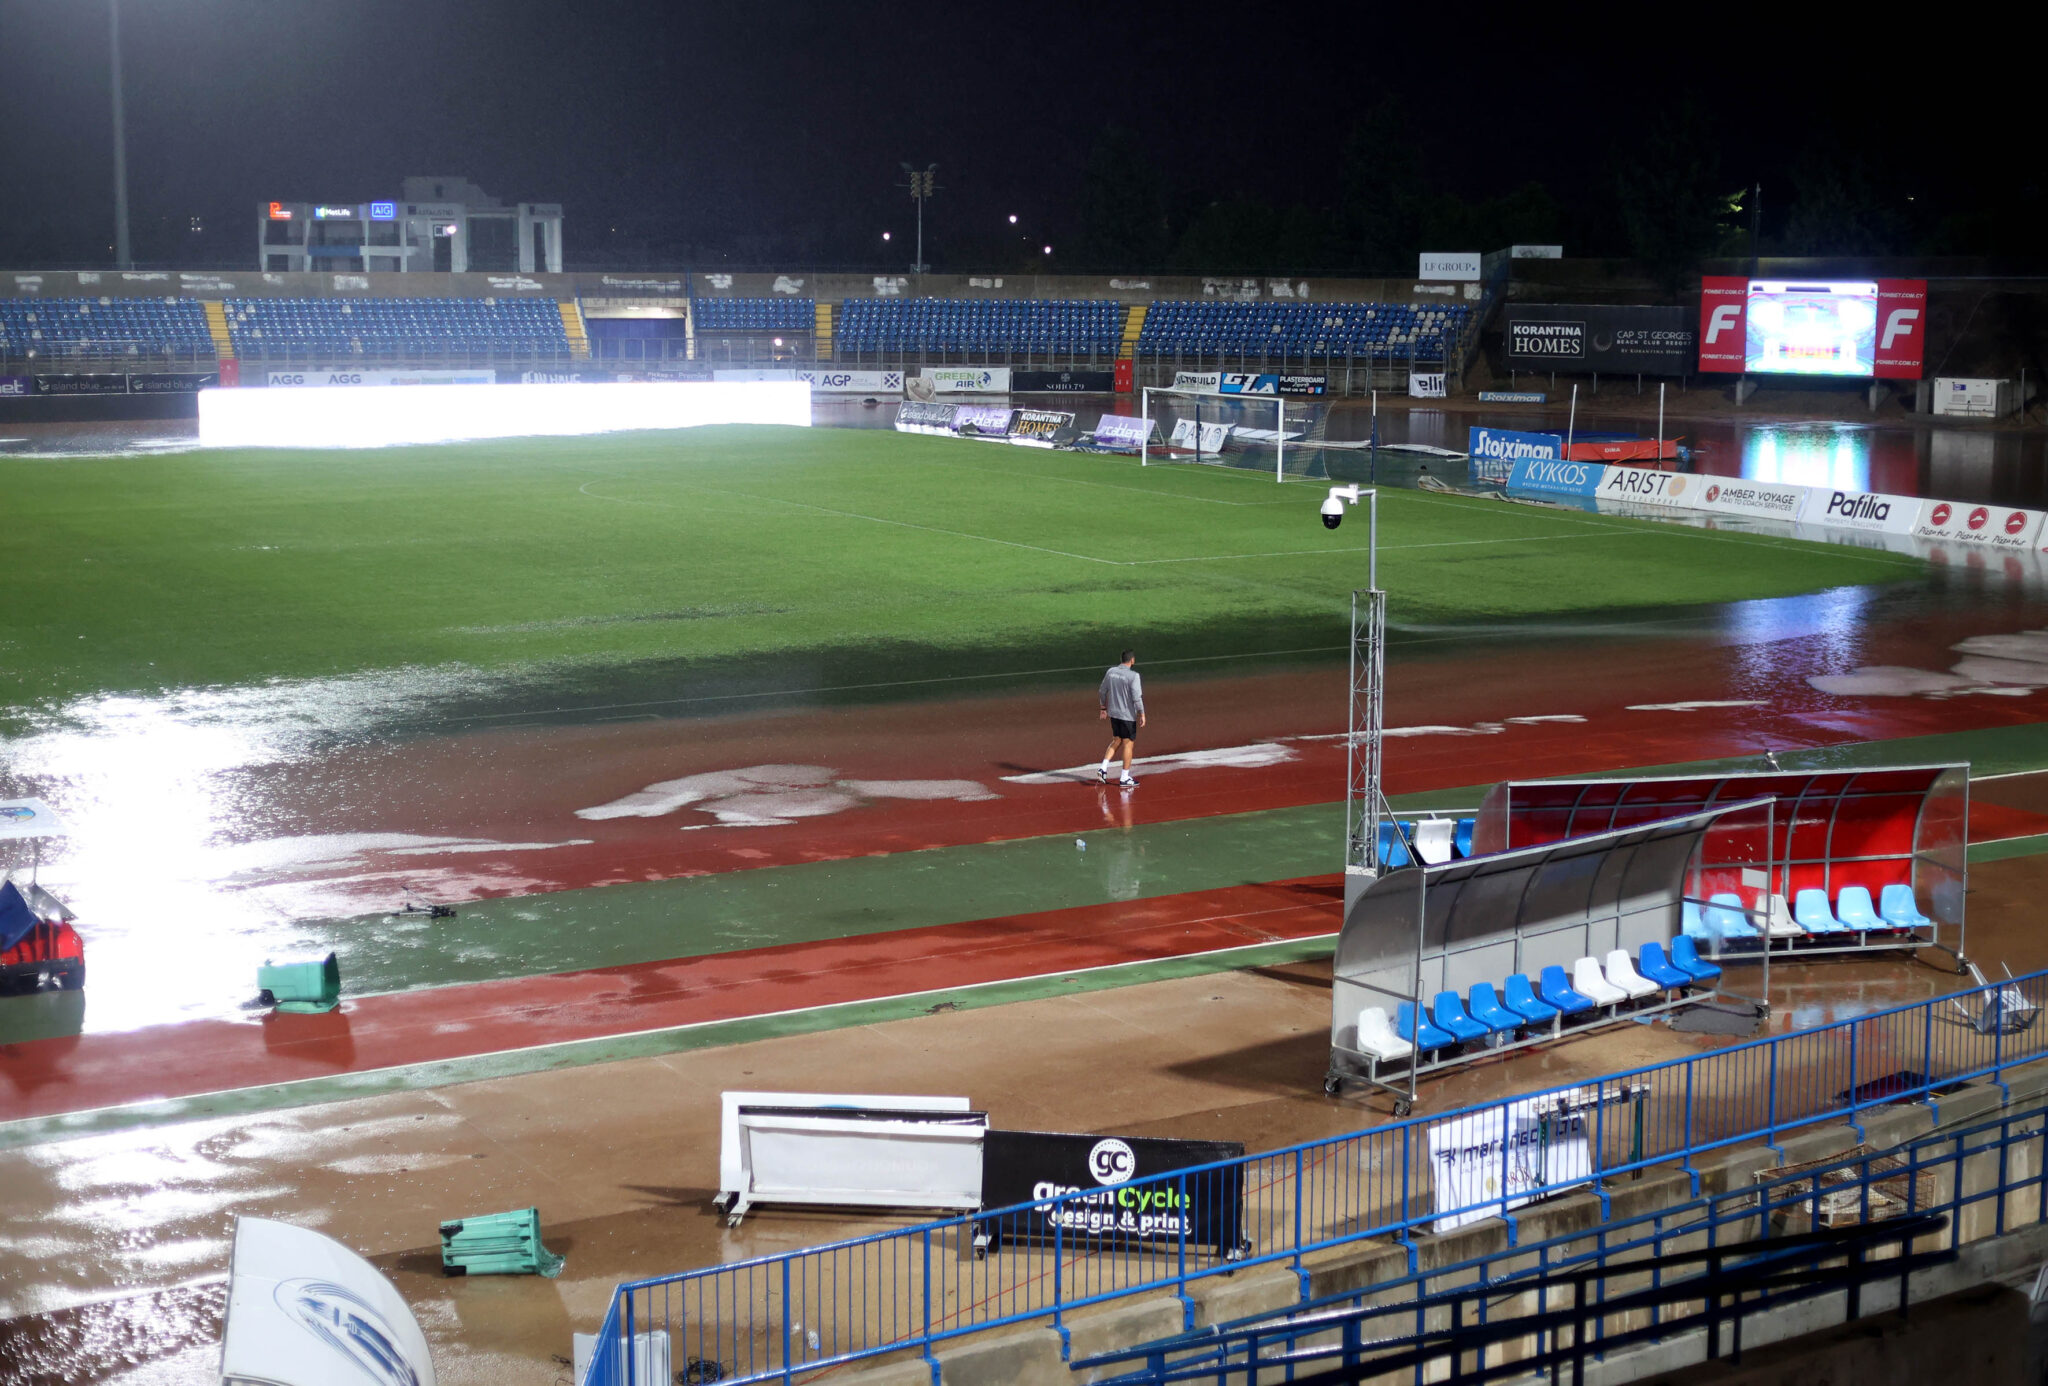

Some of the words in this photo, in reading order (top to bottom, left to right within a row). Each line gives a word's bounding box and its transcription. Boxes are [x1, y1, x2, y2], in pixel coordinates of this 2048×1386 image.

[373, 205, 392, 216] AIG
[1424, 262, 1435, 271] LF
[1705, 304, 1742, 344] F
[1880, 308, 1920, 349] F
[1513, 325, 1581, 336] KORANTINA
[1617, 331, 1634, 339] CAP
[1638, 331, 1648, 339] ST
[1651, 331, 1692, 340] GEORGES
[1515, 338, 1580, 354] HOMES
[271, 375, 304, 385] AGG
[328, 374, 361, 384] AGG
[822, 375, 851, 386] AGP
[935, 372, 975, 380] GREEN
[1280, 376, 1325, 384] PLASTERBOARD
[51, 381, 78, 391] island
[80, 380, 100, 390] blue
[173, 379, 193, 389] blue
[955, 380, 975, 388] AIR
[1485, 392, 1541, 402] Stoiximan
[1021, 412, 1062, 424] KORANTINA
[1475, 430, 1554, 459] Stoiximan
[1525, 460, 1590, 485] KYKKOS
[1620, 493, 1679, 506] DEVELOPERS
[1721, 488, 1754, 499] AMBER
[1758, 492, 1796, 504] VOYAGE
[1742, 499, 1763, 507] COACH
[1764, 501, 1793, 511] SERVICES
[1827, 491, 1891, 520] Pafilia
[1918, 526, 1936, 536] Pizza
[1954, 531, 1973, 540] Pizza
[1992, 536, 2010, 545] Pizza
[1096, 1150, 1128, 1177] gc
[1033, 1181, 1114, 1211] green
[1051, 1207, 1114, 1228] design
[1121, 1211, 1135, 1226] &
[1140, 1213, 1189, 1230] print
